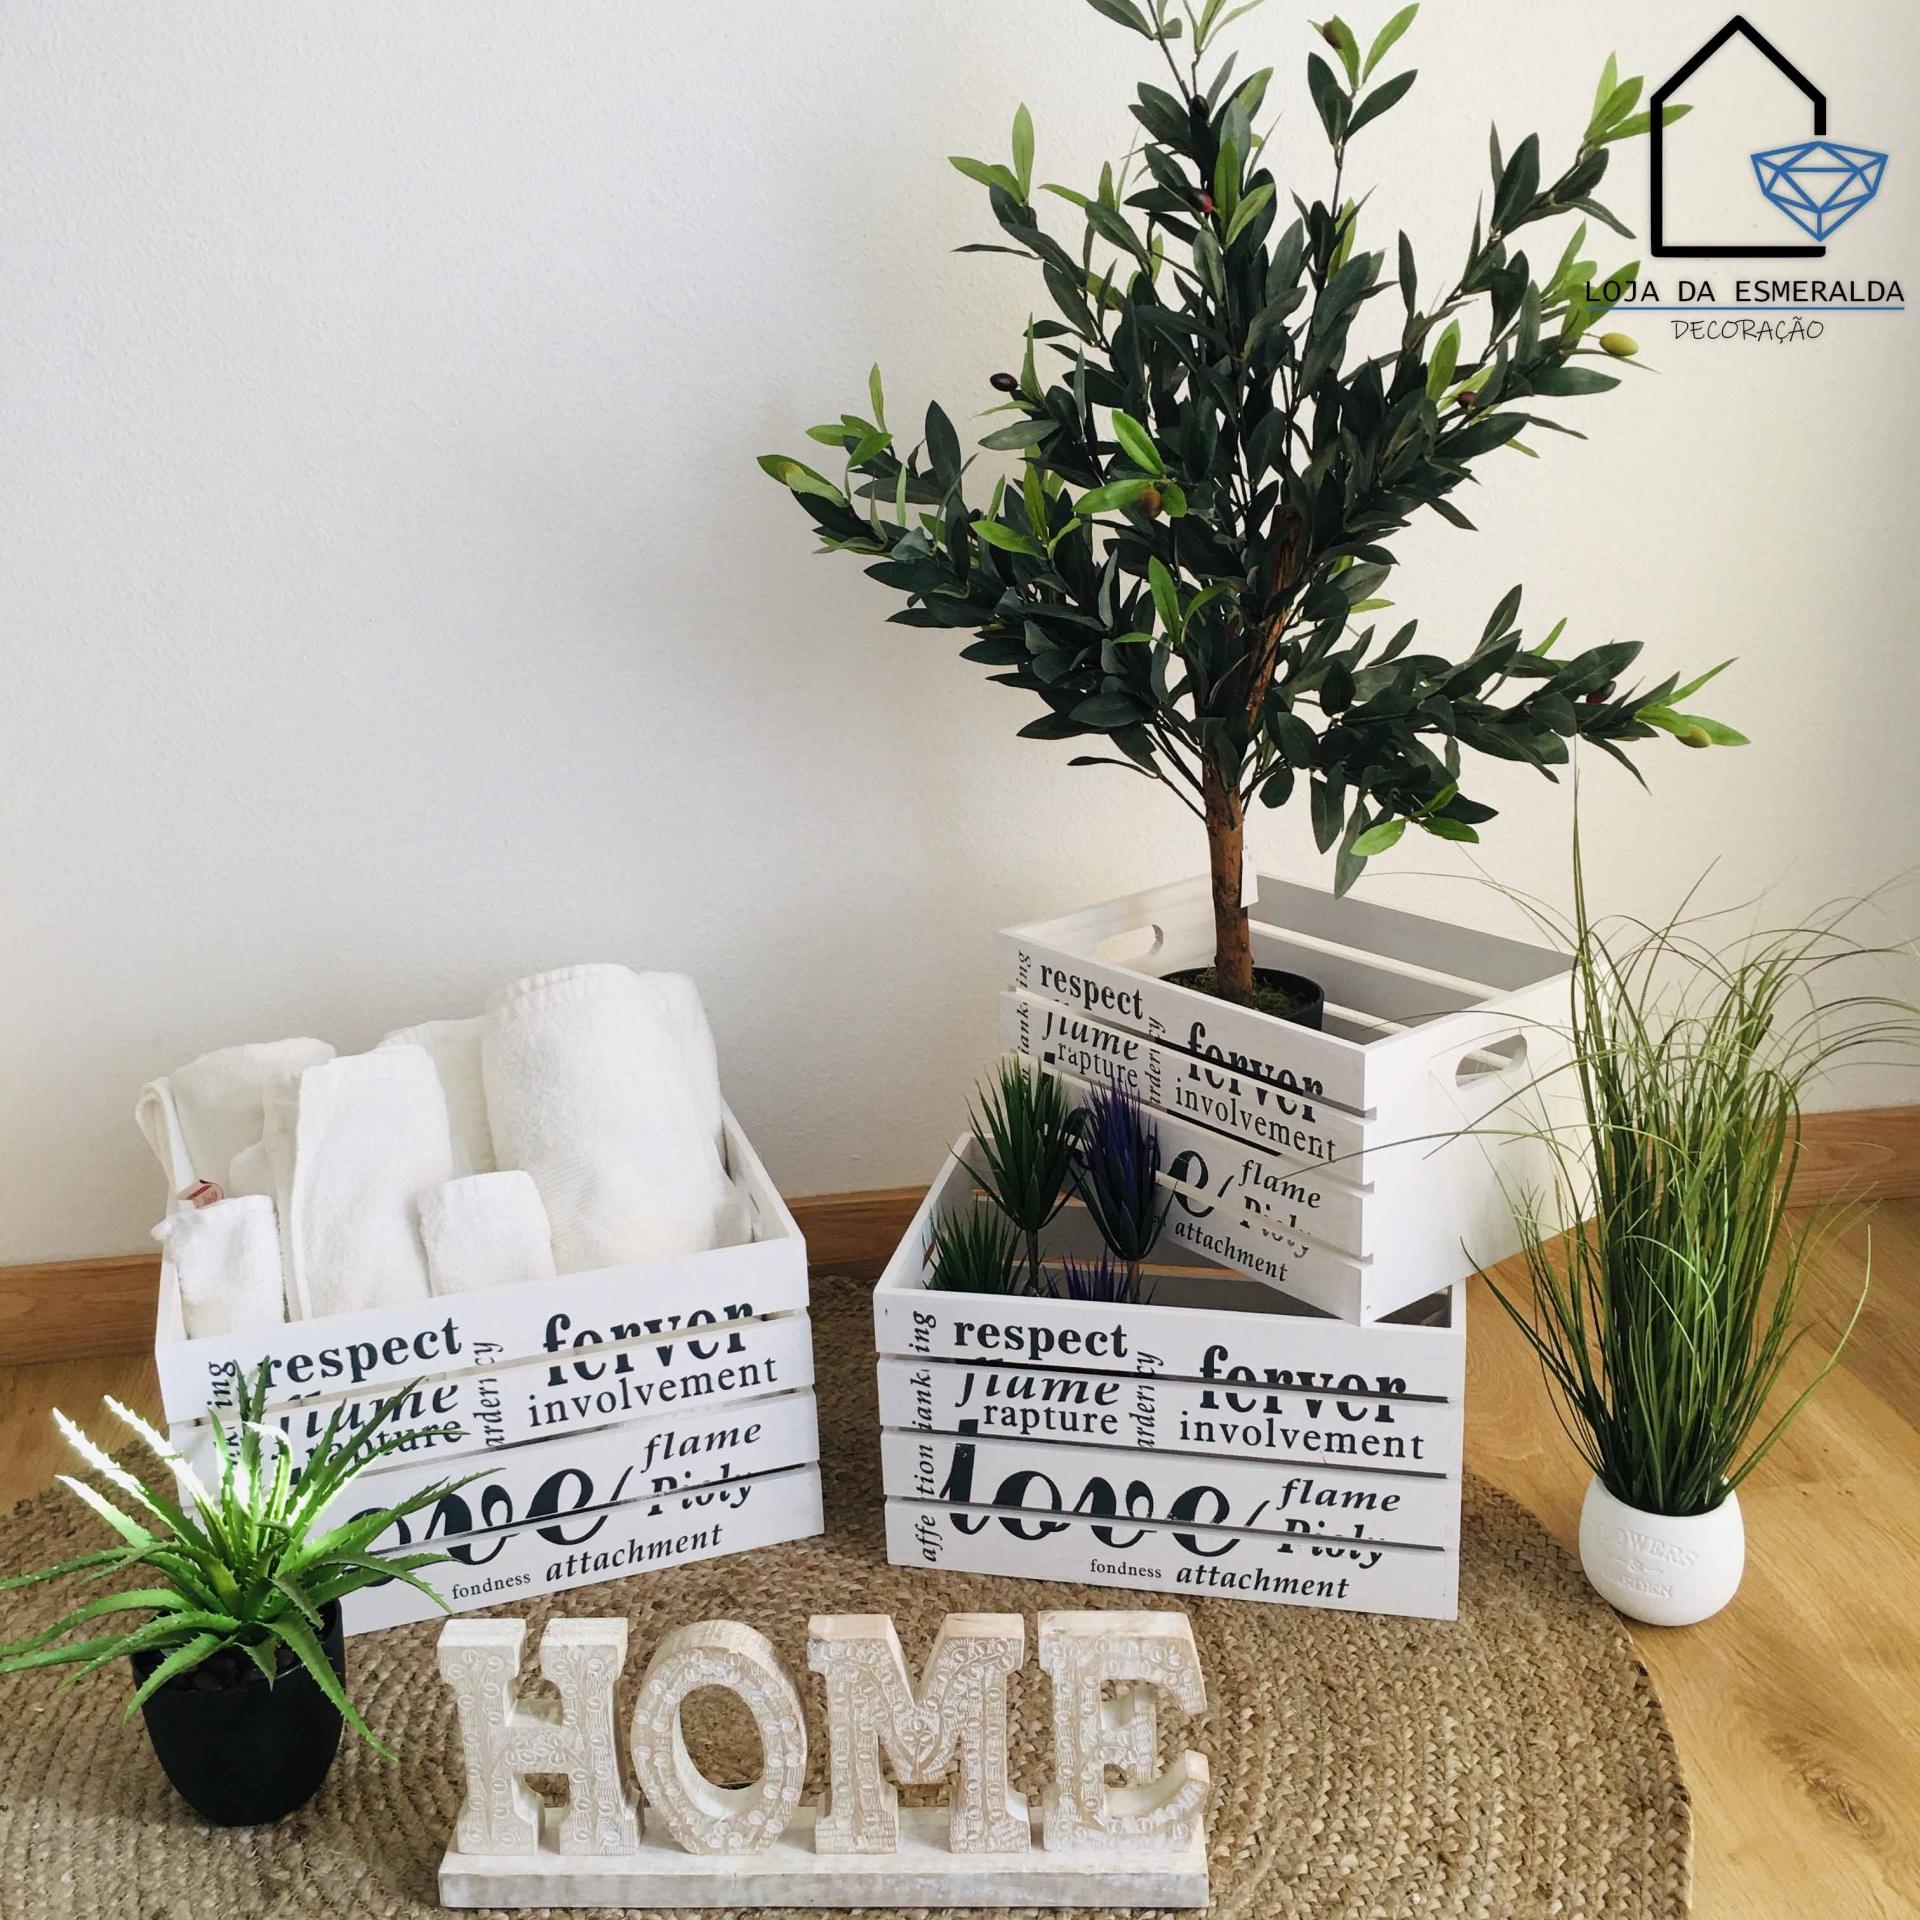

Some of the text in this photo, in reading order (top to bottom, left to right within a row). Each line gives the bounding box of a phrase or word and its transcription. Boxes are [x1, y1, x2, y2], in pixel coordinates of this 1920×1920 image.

[1040, 964, 1143, 1020] respect
[1058, 1043, 1138, 1087] rapture
[1176, 1078, 1336, 1162] involvement
[1238, 1159, 1321, 1209] flame
[1175, 1220, 1288, 1281] attachment
[258, 1318, 462, 1388] respect
[954, 1322, 1128, 1361] respect
[528, 1357, 778, 1427] involvement
[983, 1403, 1118, 1435] rapture
[1180, 1410, 1424, 1460] involvement
[640, 1423, 761, 1473] flame
[939, 1418, 1270, 1558] love
[1276, 1477, 1401, 1512] flame
[546, 1524, 723, 1582] attachment
[1090, 1559, 1162, 1579] fondness
[451, 1571, 531, 1600] fondness
[1176, 1564, 1350, 1599] attachment
[437, 1610, 1210, 1856] HOME
